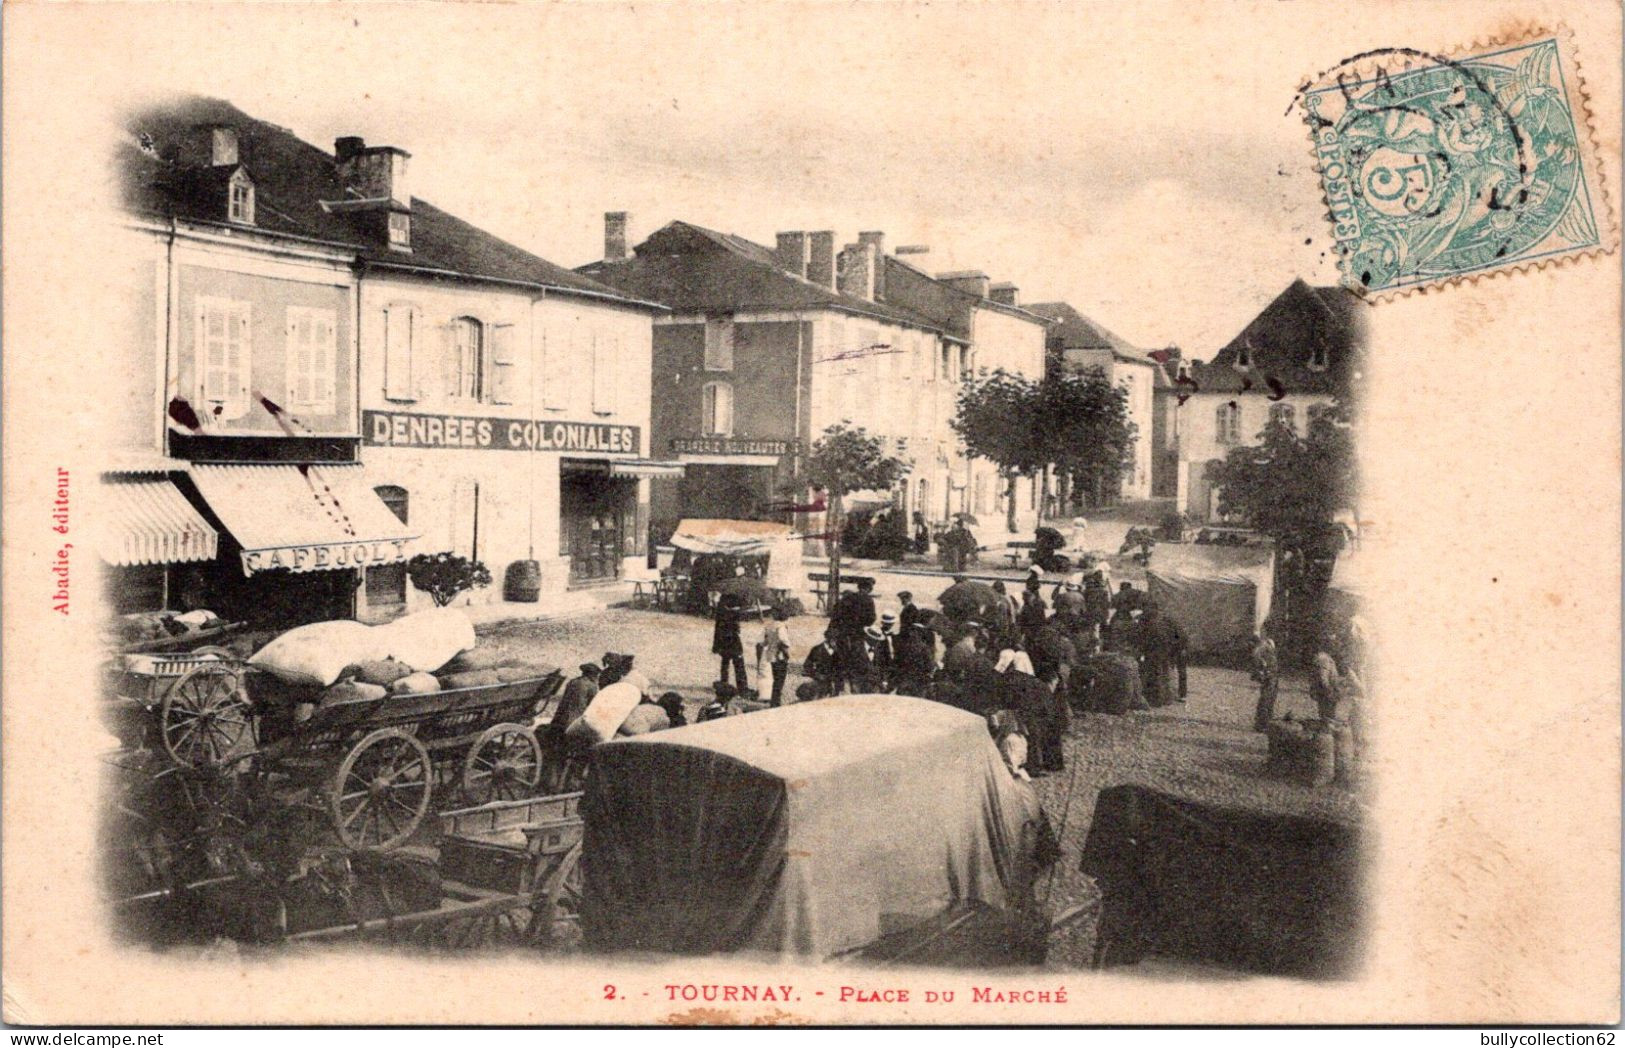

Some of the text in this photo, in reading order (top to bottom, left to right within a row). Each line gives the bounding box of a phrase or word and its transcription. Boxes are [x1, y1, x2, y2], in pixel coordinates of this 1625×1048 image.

[1319, 150, 1357, 236] POSTES
[373, 414, 634, 451] DENRÉES COLONIALES
[52, 466, 74, 616] Abadie, éditeur
[603, 984, 626, 1000] 2.
[665, 984, 802, 1002] TOURNAY.
